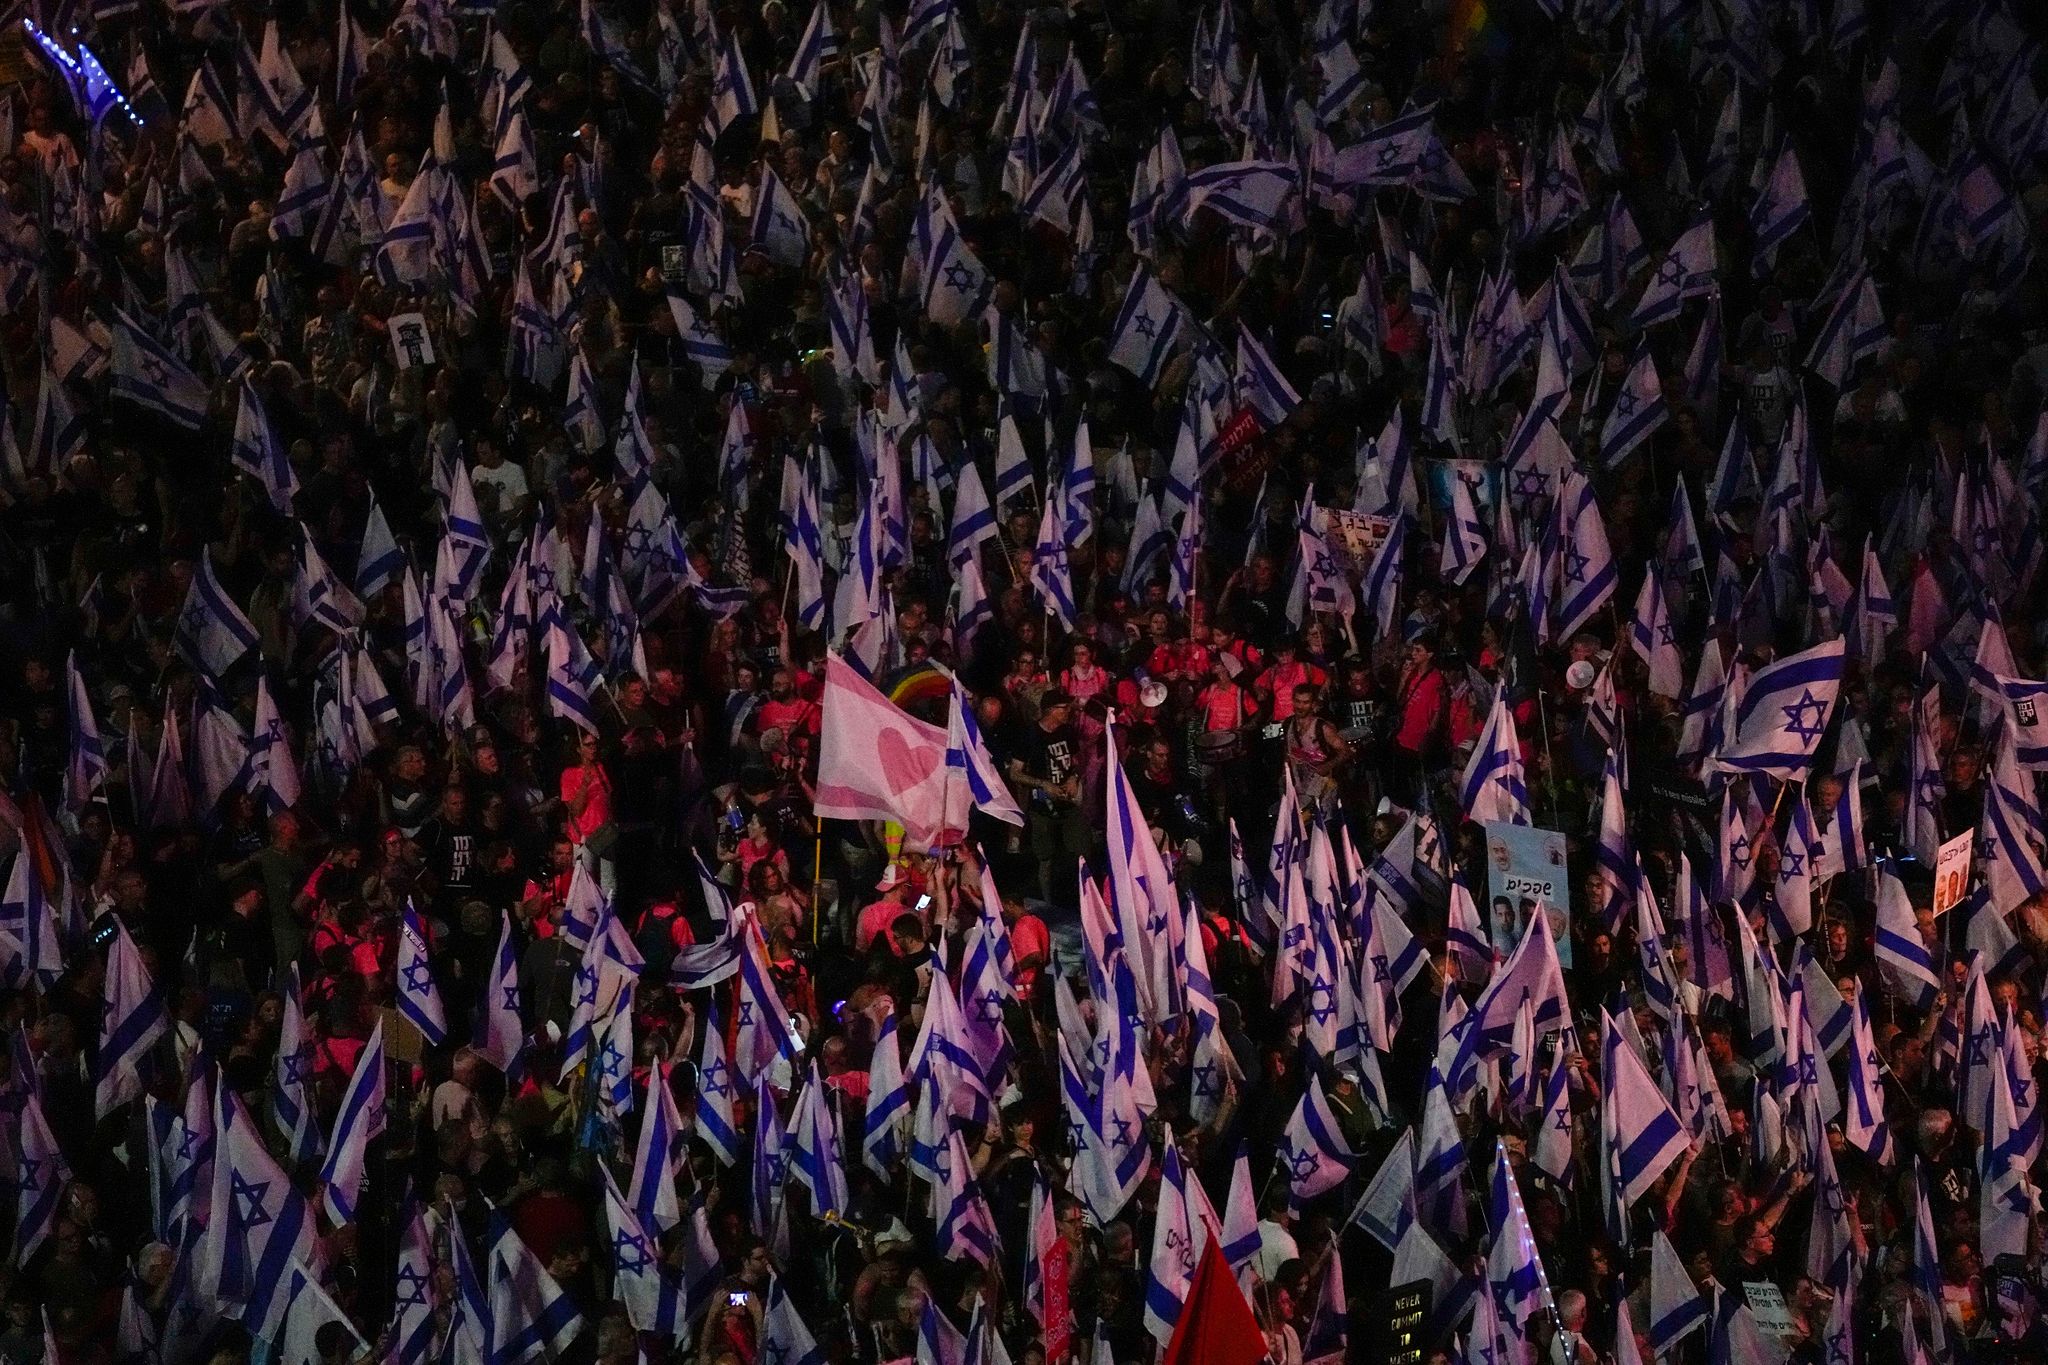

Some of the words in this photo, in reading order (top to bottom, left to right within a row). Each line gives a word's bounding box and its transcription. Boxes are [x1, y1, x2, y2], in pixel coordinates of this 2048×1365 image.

[1350, 700, 1374, 715] דמו
[2017, 701, 2032, 711] דמו
[1047, 740, 1069, 757] דמו
[1395, 1293, 1421, 1311] NEVER
[1391, 1311, 1423, 1330] COMMIT
[1400, 1332, 1411, 1346] TO
